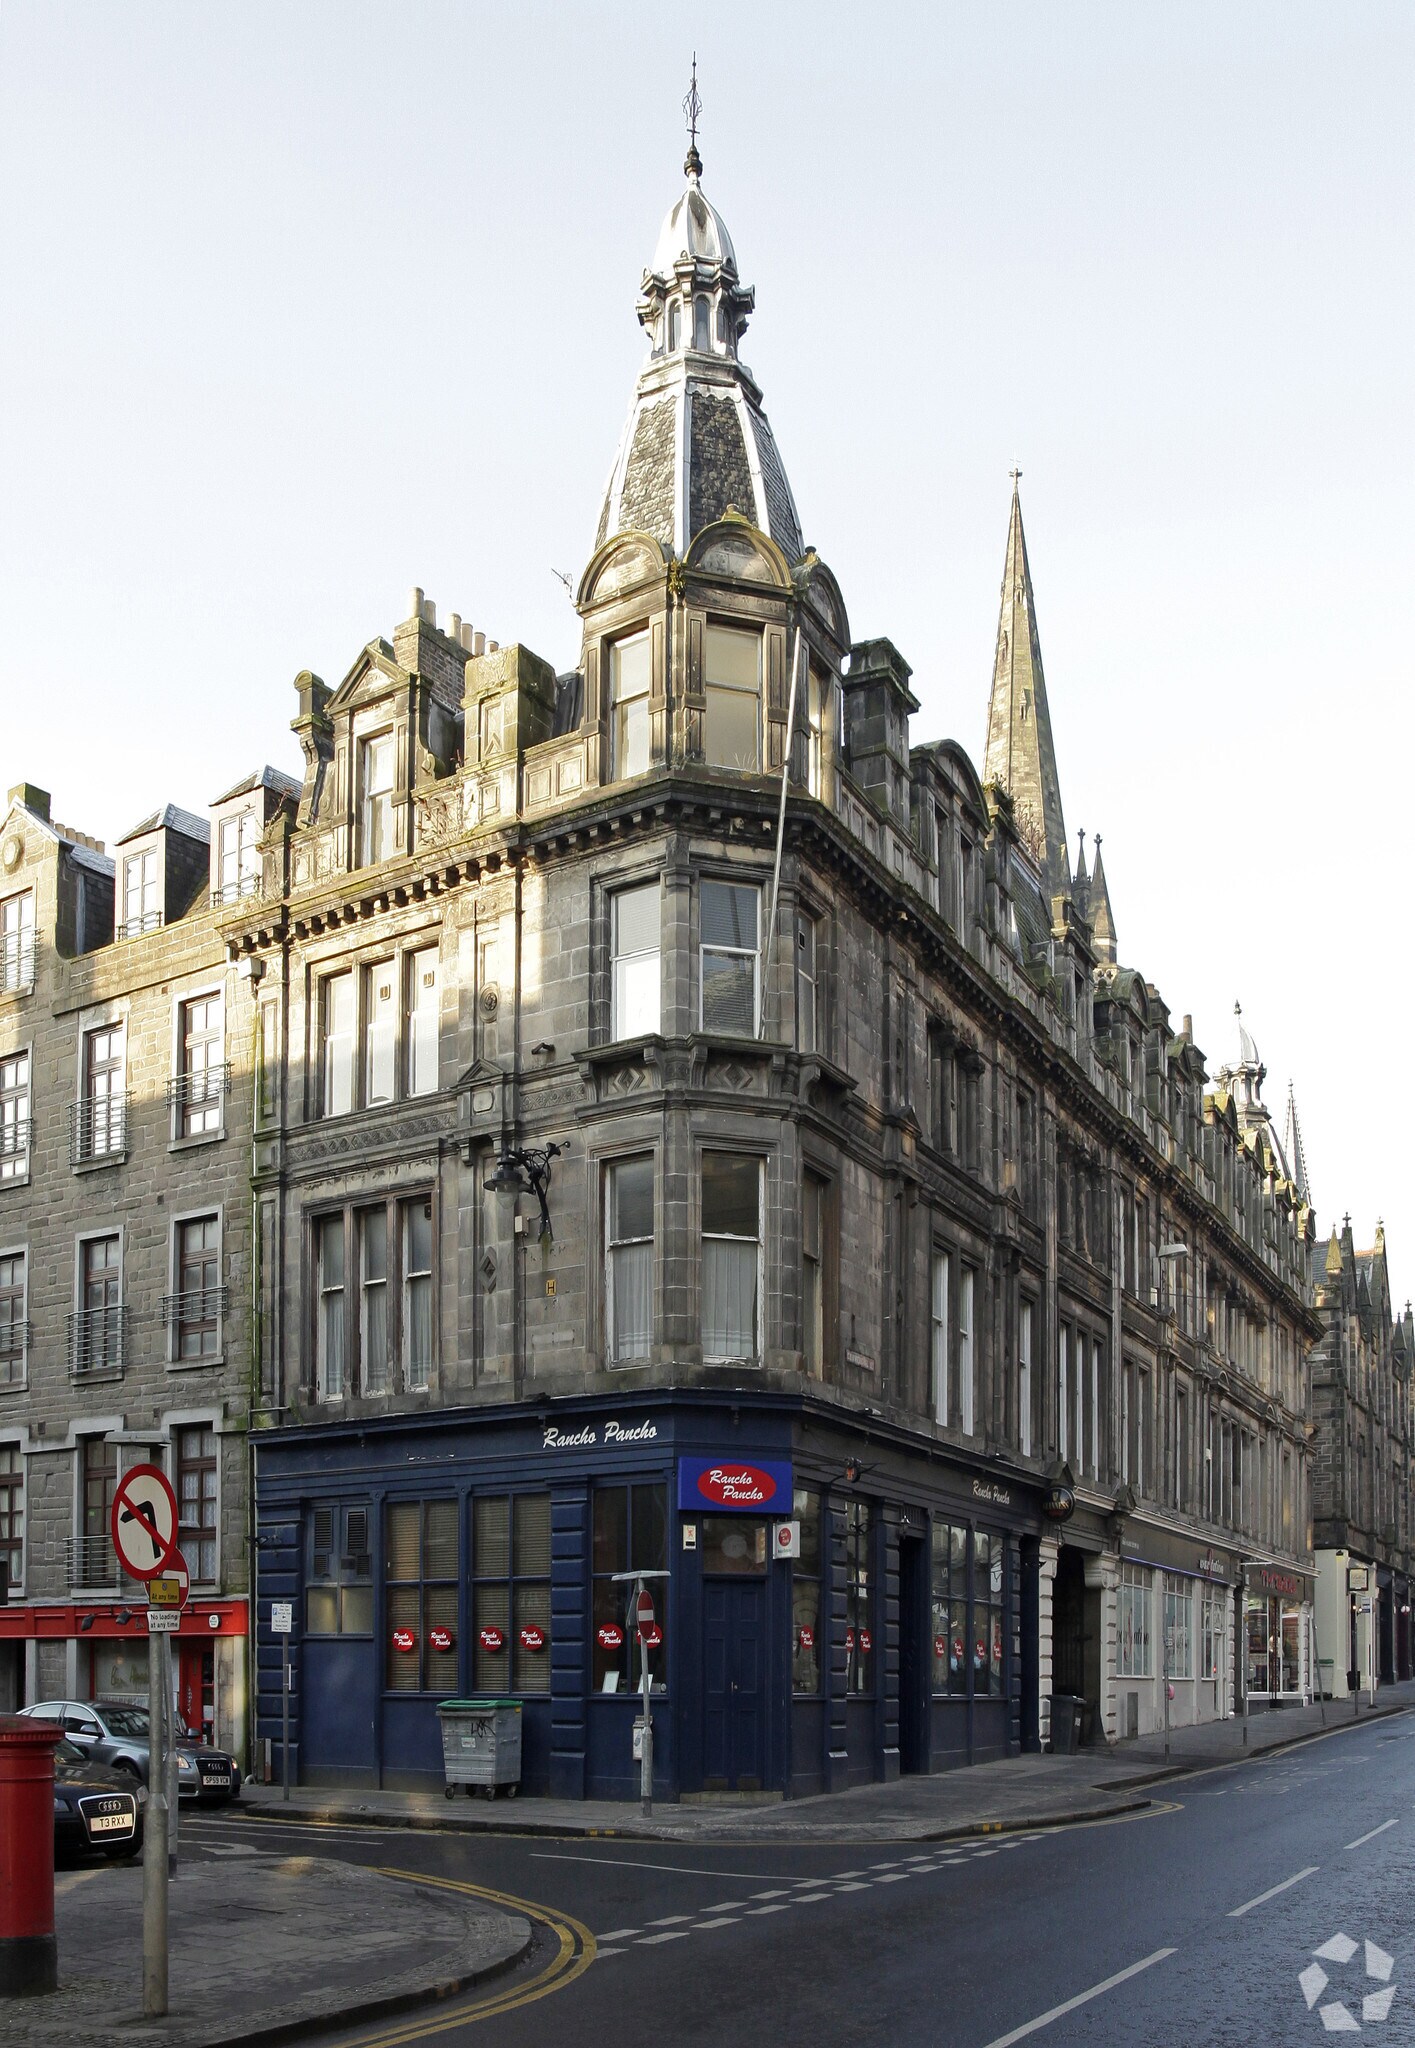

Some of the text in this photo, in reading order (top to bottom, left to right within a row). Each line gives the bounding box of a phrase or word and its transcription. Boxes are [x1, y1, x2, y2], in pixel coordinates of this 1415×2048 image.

[543, 1420, 657, 1448] Rancho Pancho
[709, 1470, 753, 1484] Rancho
[722, 1485, 764, 1500] Pancho
[973, 1480, 1010, 1504] Rancho Pancho
[100, 1817, 126, 1828] T3 RXX
